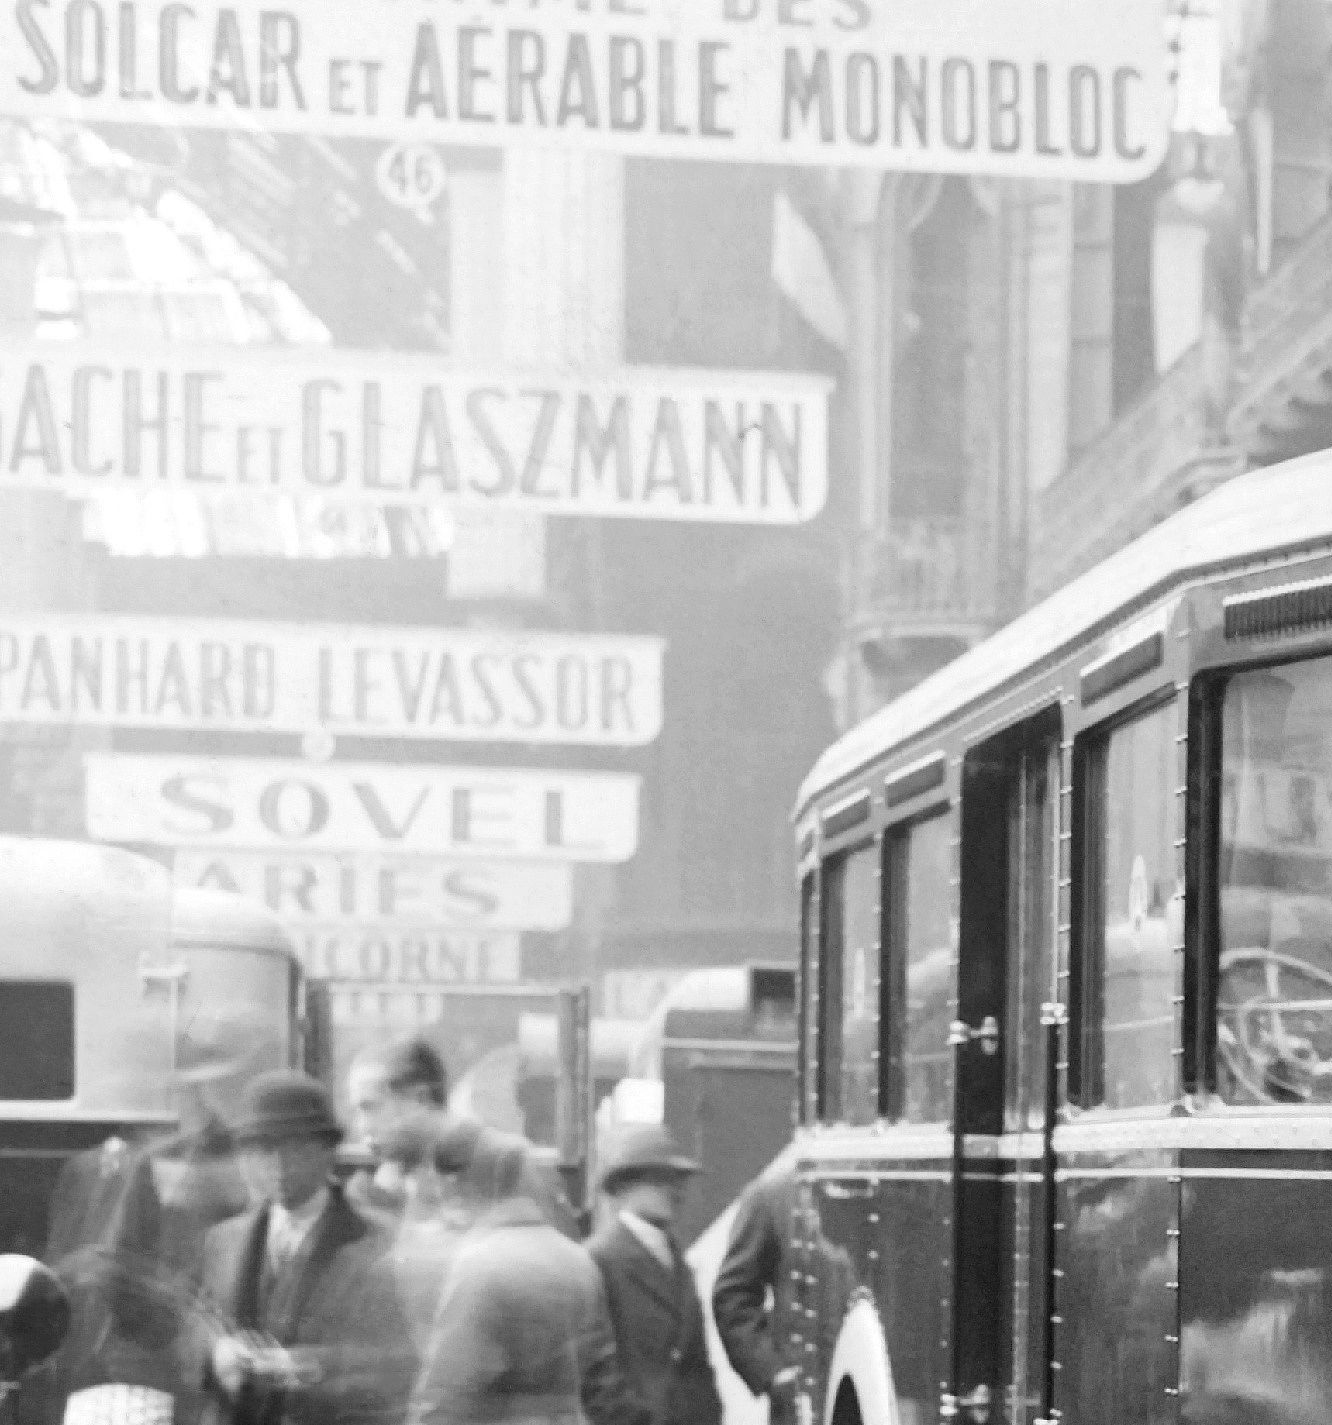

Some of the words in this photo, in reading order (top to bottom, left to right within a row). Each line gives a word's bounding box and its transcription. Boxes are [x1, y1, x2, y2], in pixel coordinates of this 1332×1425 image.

[14, 0, 308, 111] SOLCAR
[328, 58, 383, 116] ET
[780, 46, 1148, 163] MONOBLOC
[8, 363, 226, 481] ACHE
[237, 425, 284, 485] ET
[302, 378, 802, 509] GLASZMANN
[317, 647, 637, 733] LEVASSOR
[159, 774, 606, 849] SOVEL
